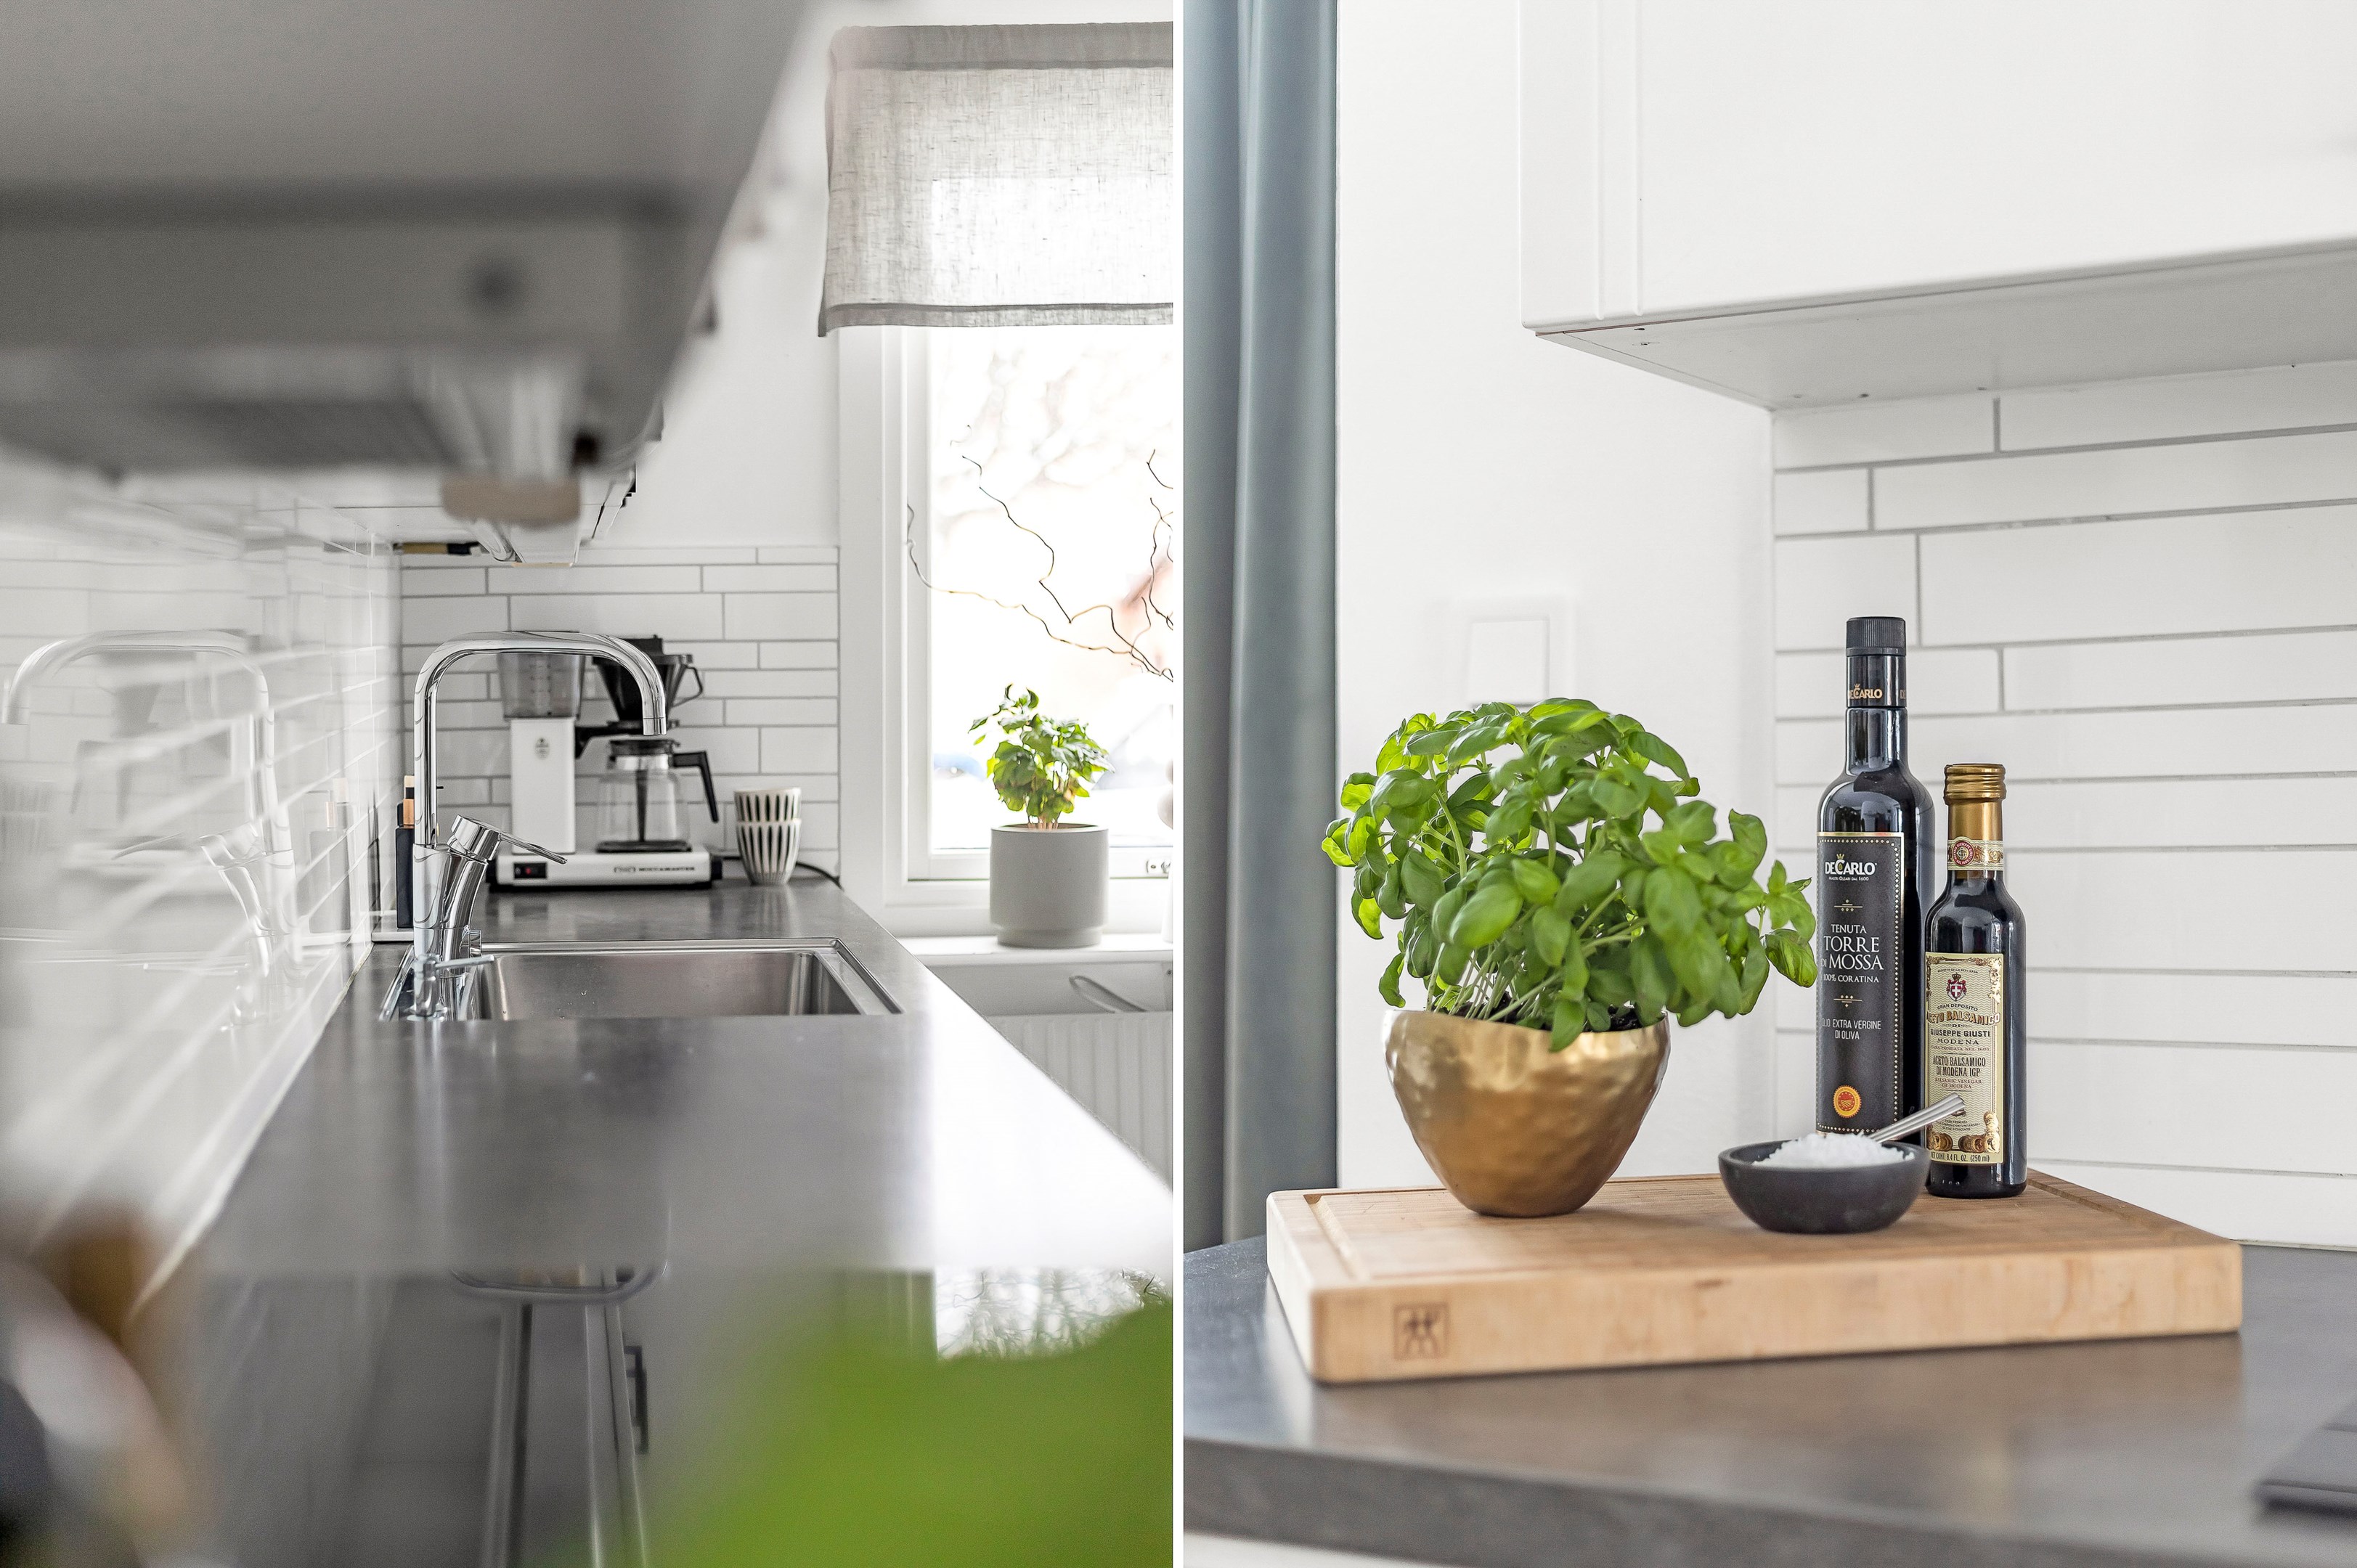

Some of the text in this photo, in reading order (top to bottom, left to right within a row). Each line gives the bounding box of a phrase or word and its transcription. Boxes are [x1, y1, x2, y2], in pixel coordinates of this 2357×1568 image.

[1831, 923, 1867, 934] TENUTA
[1823, 935, 1880, 952] TORRE
[1820, 953, 1884, 971] DI MOSSA
[1838, 974, 1879, 983] CORATINA
[1946, 1010, 2000, 1025] BALSAMICO
[1832, 1018, 1852, 1029] EXTRA
[1854, 1020, 1881, 1029] VERGINE
[1835, 1029, 1860, 1040] DI OLIVA
[1933, 1055, 1986, 1067] ACETO BALSAMICO
[1942, 1066, 1969, 1077] MODENA
[1969, 1067, 1981, 1077] IGP
